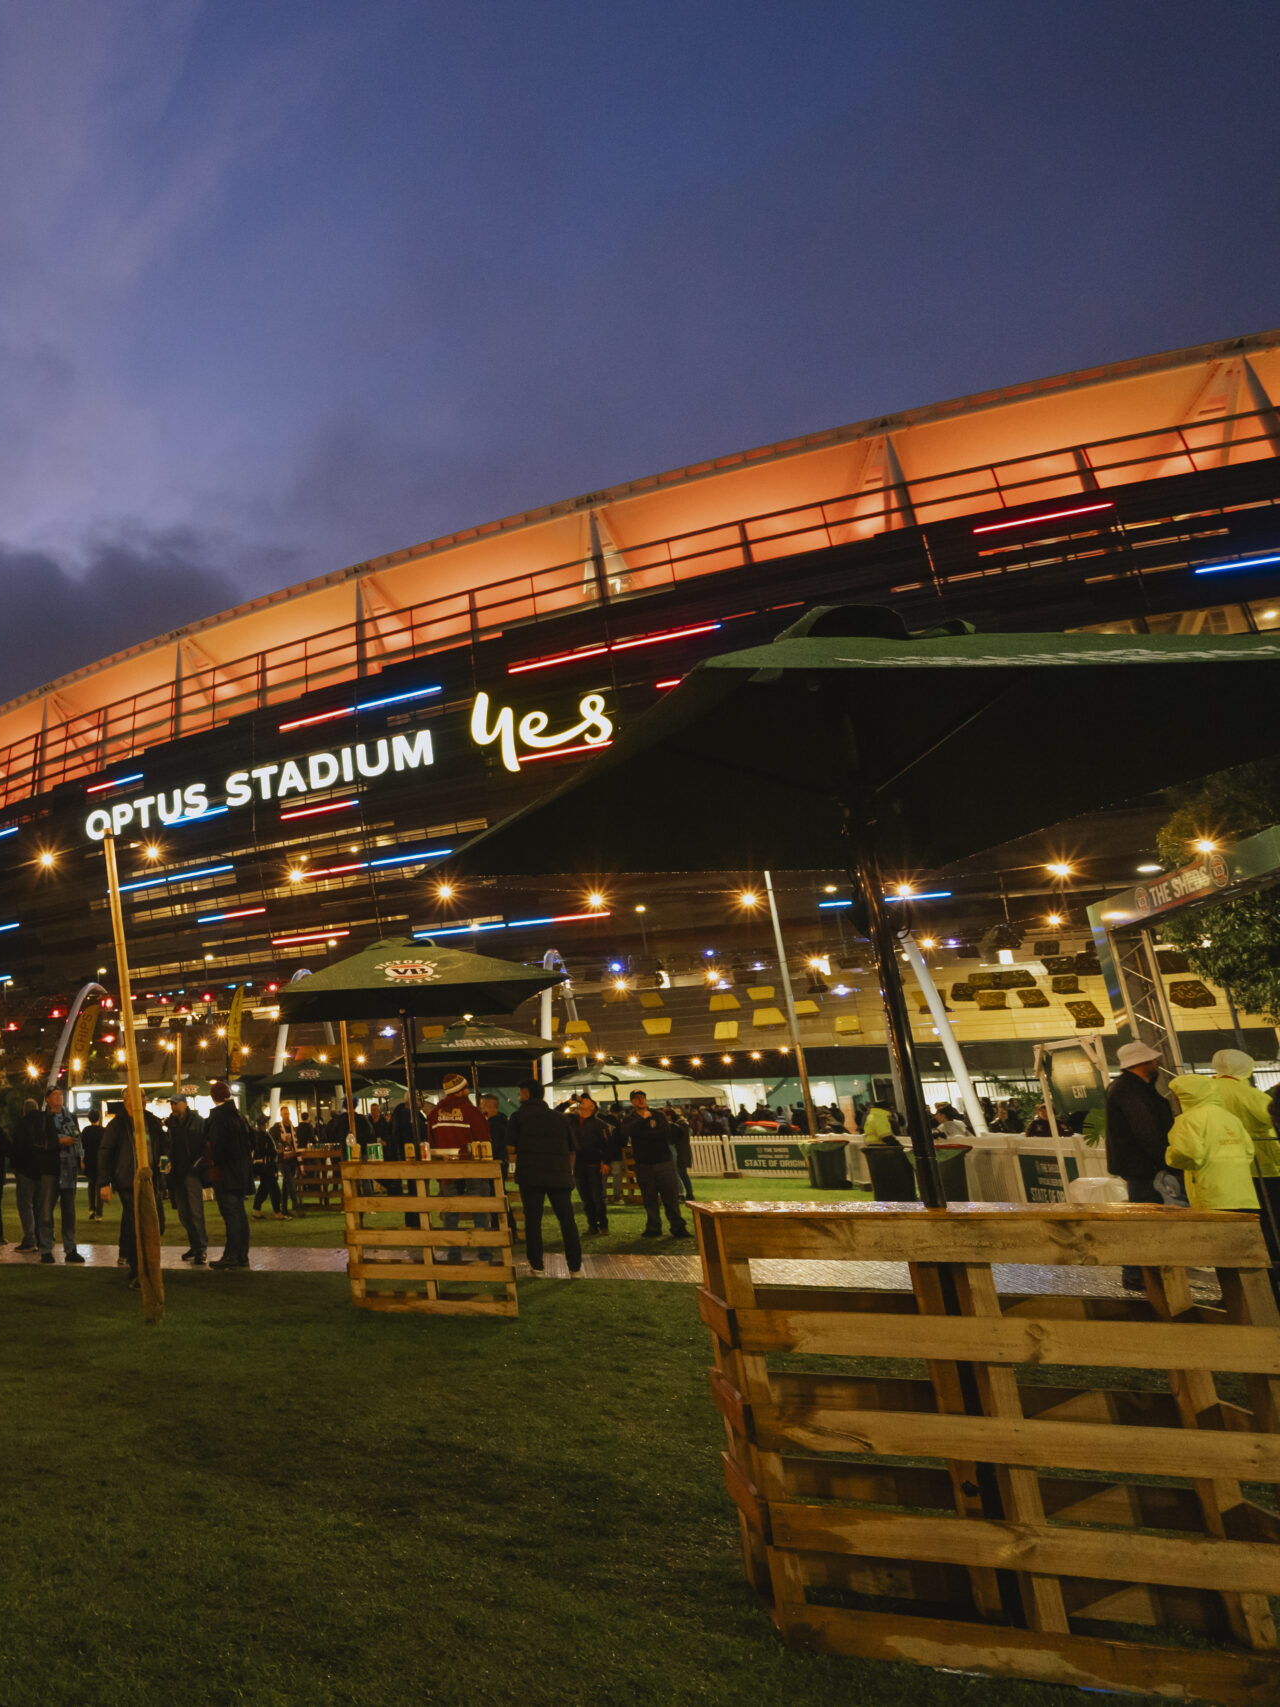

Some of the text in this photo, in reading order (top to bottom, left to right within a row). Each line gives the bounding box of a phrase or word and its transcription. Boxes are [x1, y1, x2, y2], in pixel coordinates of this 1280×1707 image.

[85, 729, 435, 841] OPTUS STADIUM
[1148, 866, 1210, 907] THE SHEDS
[391, 967, 429, 975] VB
[75, 1012, 93, 1052] CHIPS
[744, 1159, 767, 1168] STATE
